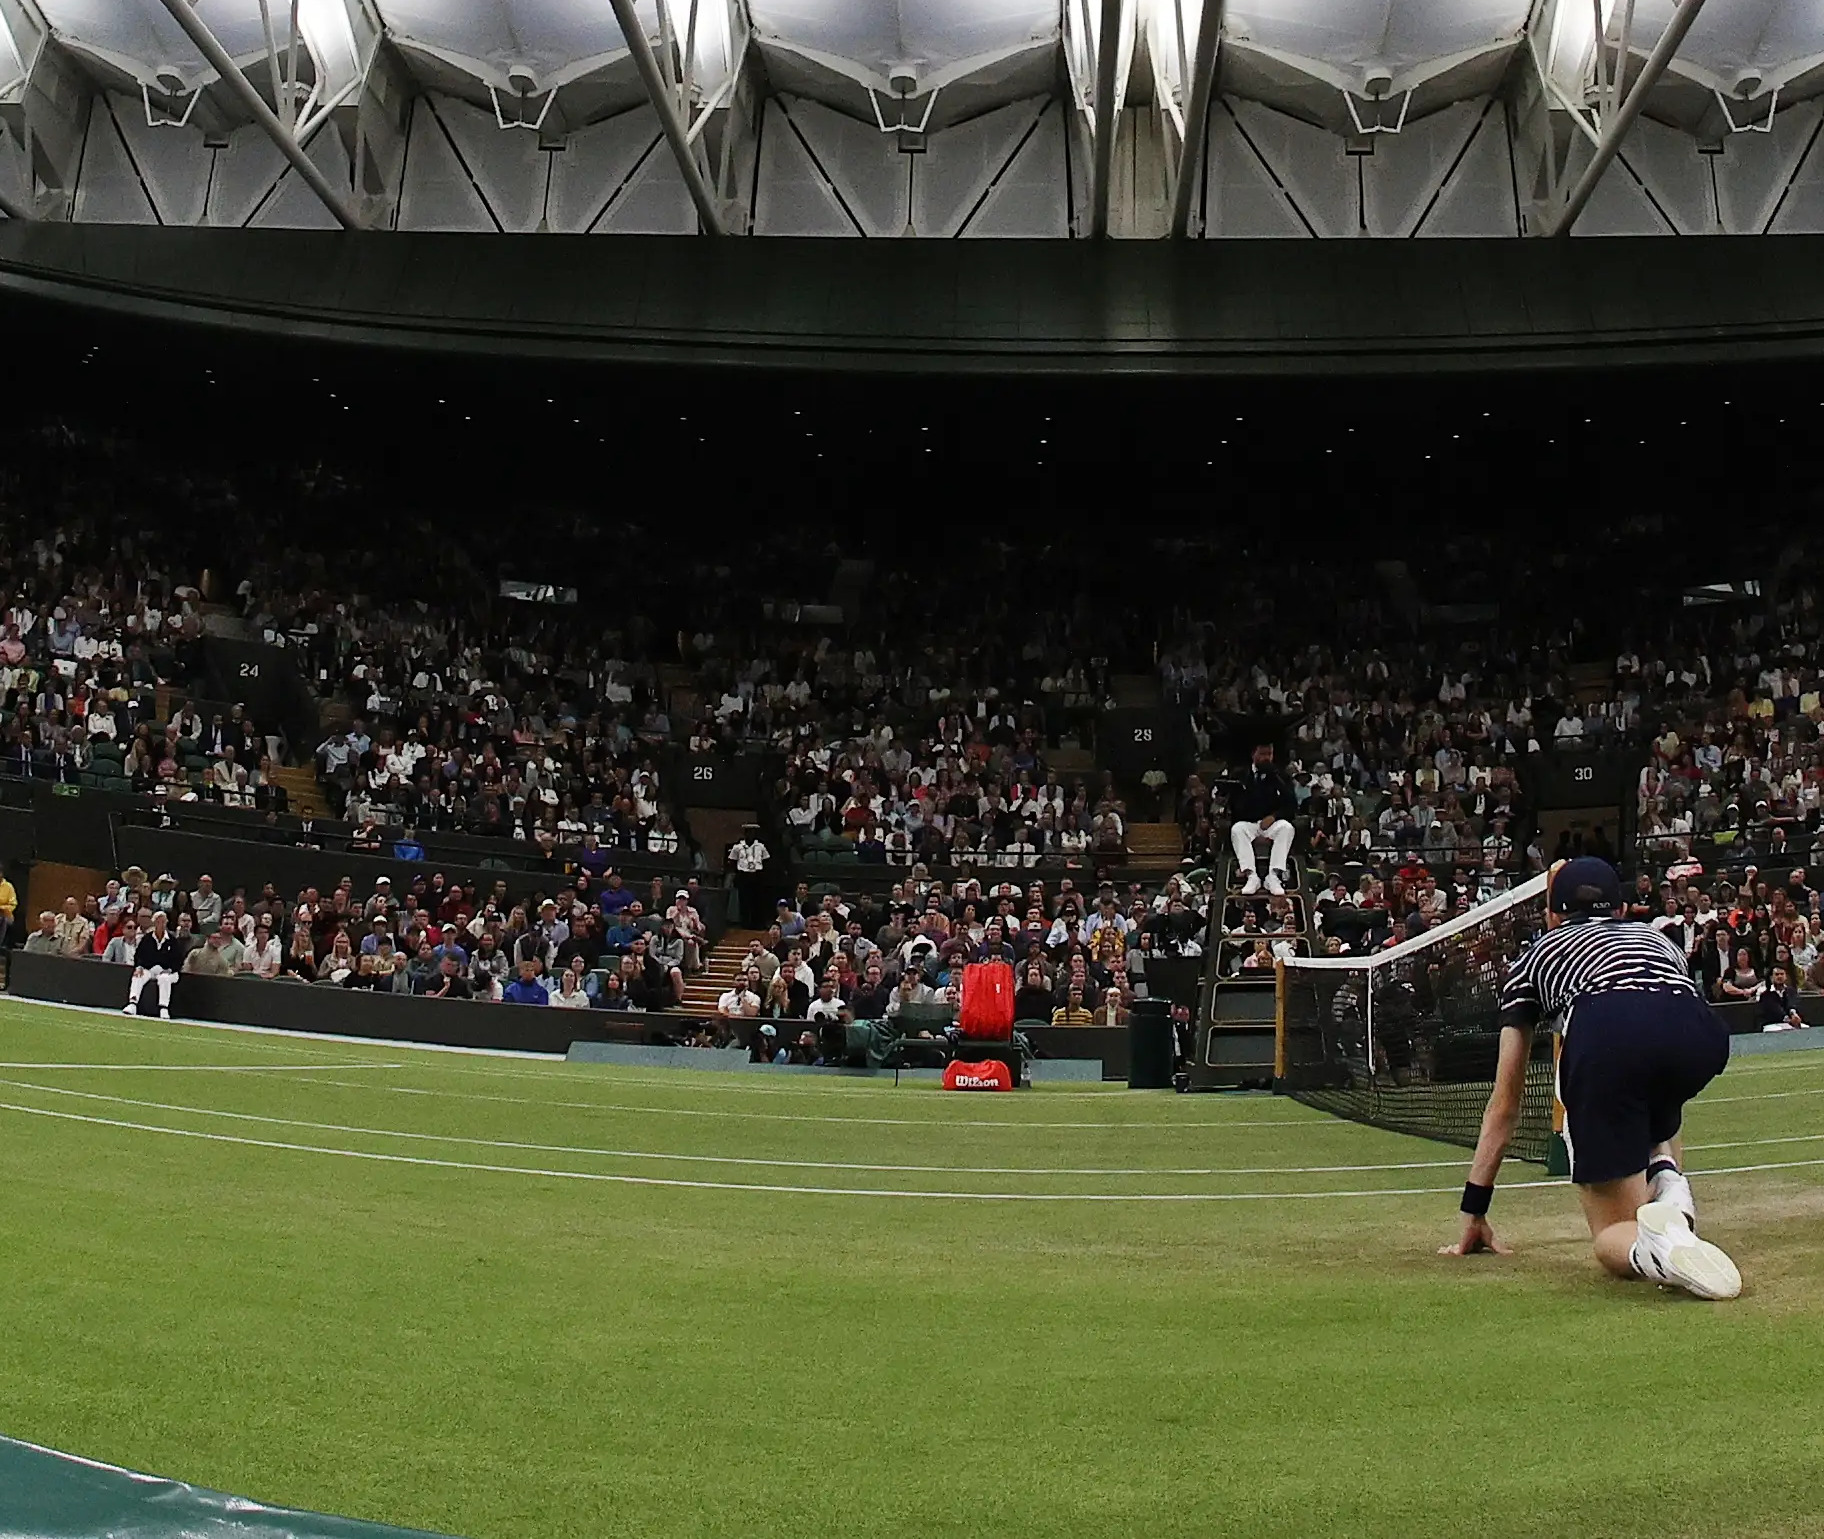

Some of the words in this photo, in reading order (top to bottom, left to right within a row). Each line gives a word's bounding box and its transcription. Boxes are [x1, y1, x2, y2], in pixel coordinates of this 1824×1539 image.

[239, 663, 259, 677] 24
[1133, 728, 1152, 742] 28
[693, 766, 713, 780] 26
[1574, 766, 1593, 780] 30
[955, 1074, 999, 1087] Wilson
